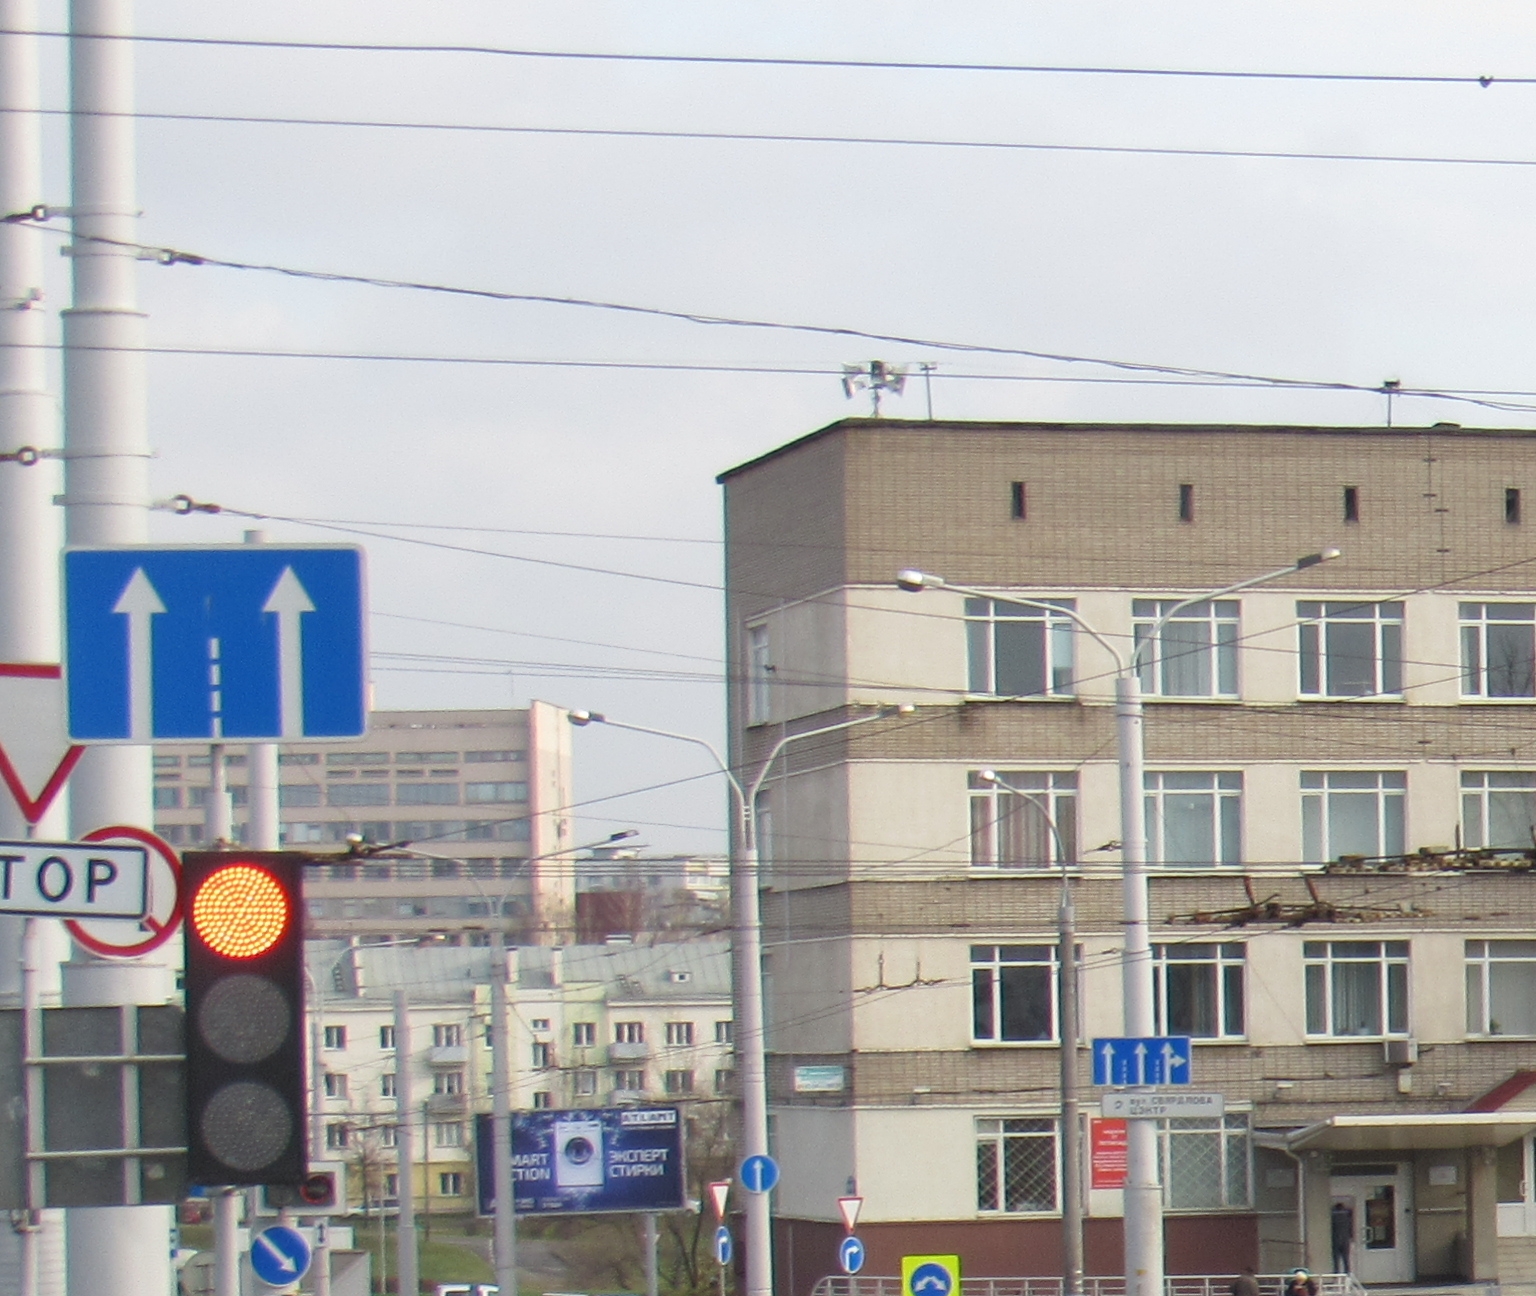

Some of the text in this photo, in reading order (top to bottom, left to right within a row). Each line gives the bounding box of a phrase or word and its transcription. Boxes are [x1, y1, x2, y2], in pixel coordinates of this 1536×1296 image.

[0, 855, 118, 903] TOP
[511, 1153, 548, 1167] MART
[608, 1148, 670, 1165] ЭКСПЕРТ
[608, 1163, 665, 1179] СТИРКИ
